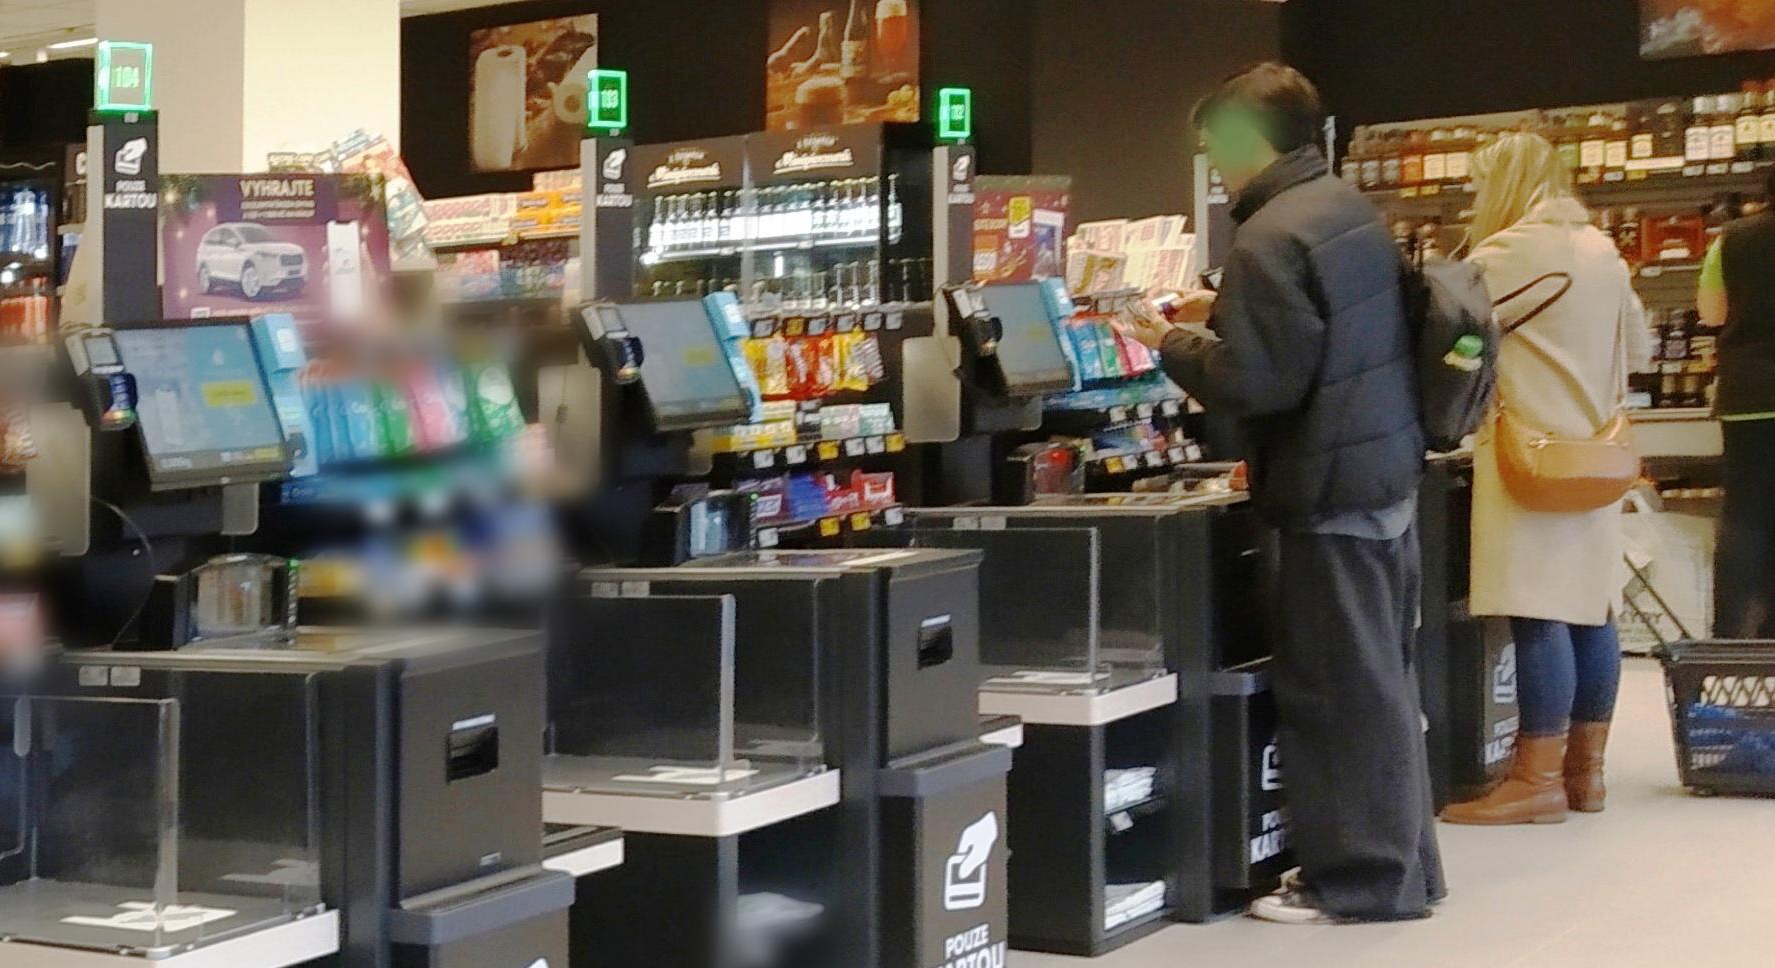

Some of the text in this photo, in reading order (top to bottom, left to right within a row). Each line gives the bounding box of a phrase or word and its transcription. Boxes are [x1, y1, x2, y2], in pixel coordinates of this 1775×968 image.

[240, 179, 315, 198] VYHRAJTE
[104, 193, 158, 209] KARTOU
[945, 923, 990, 961] POUZE
